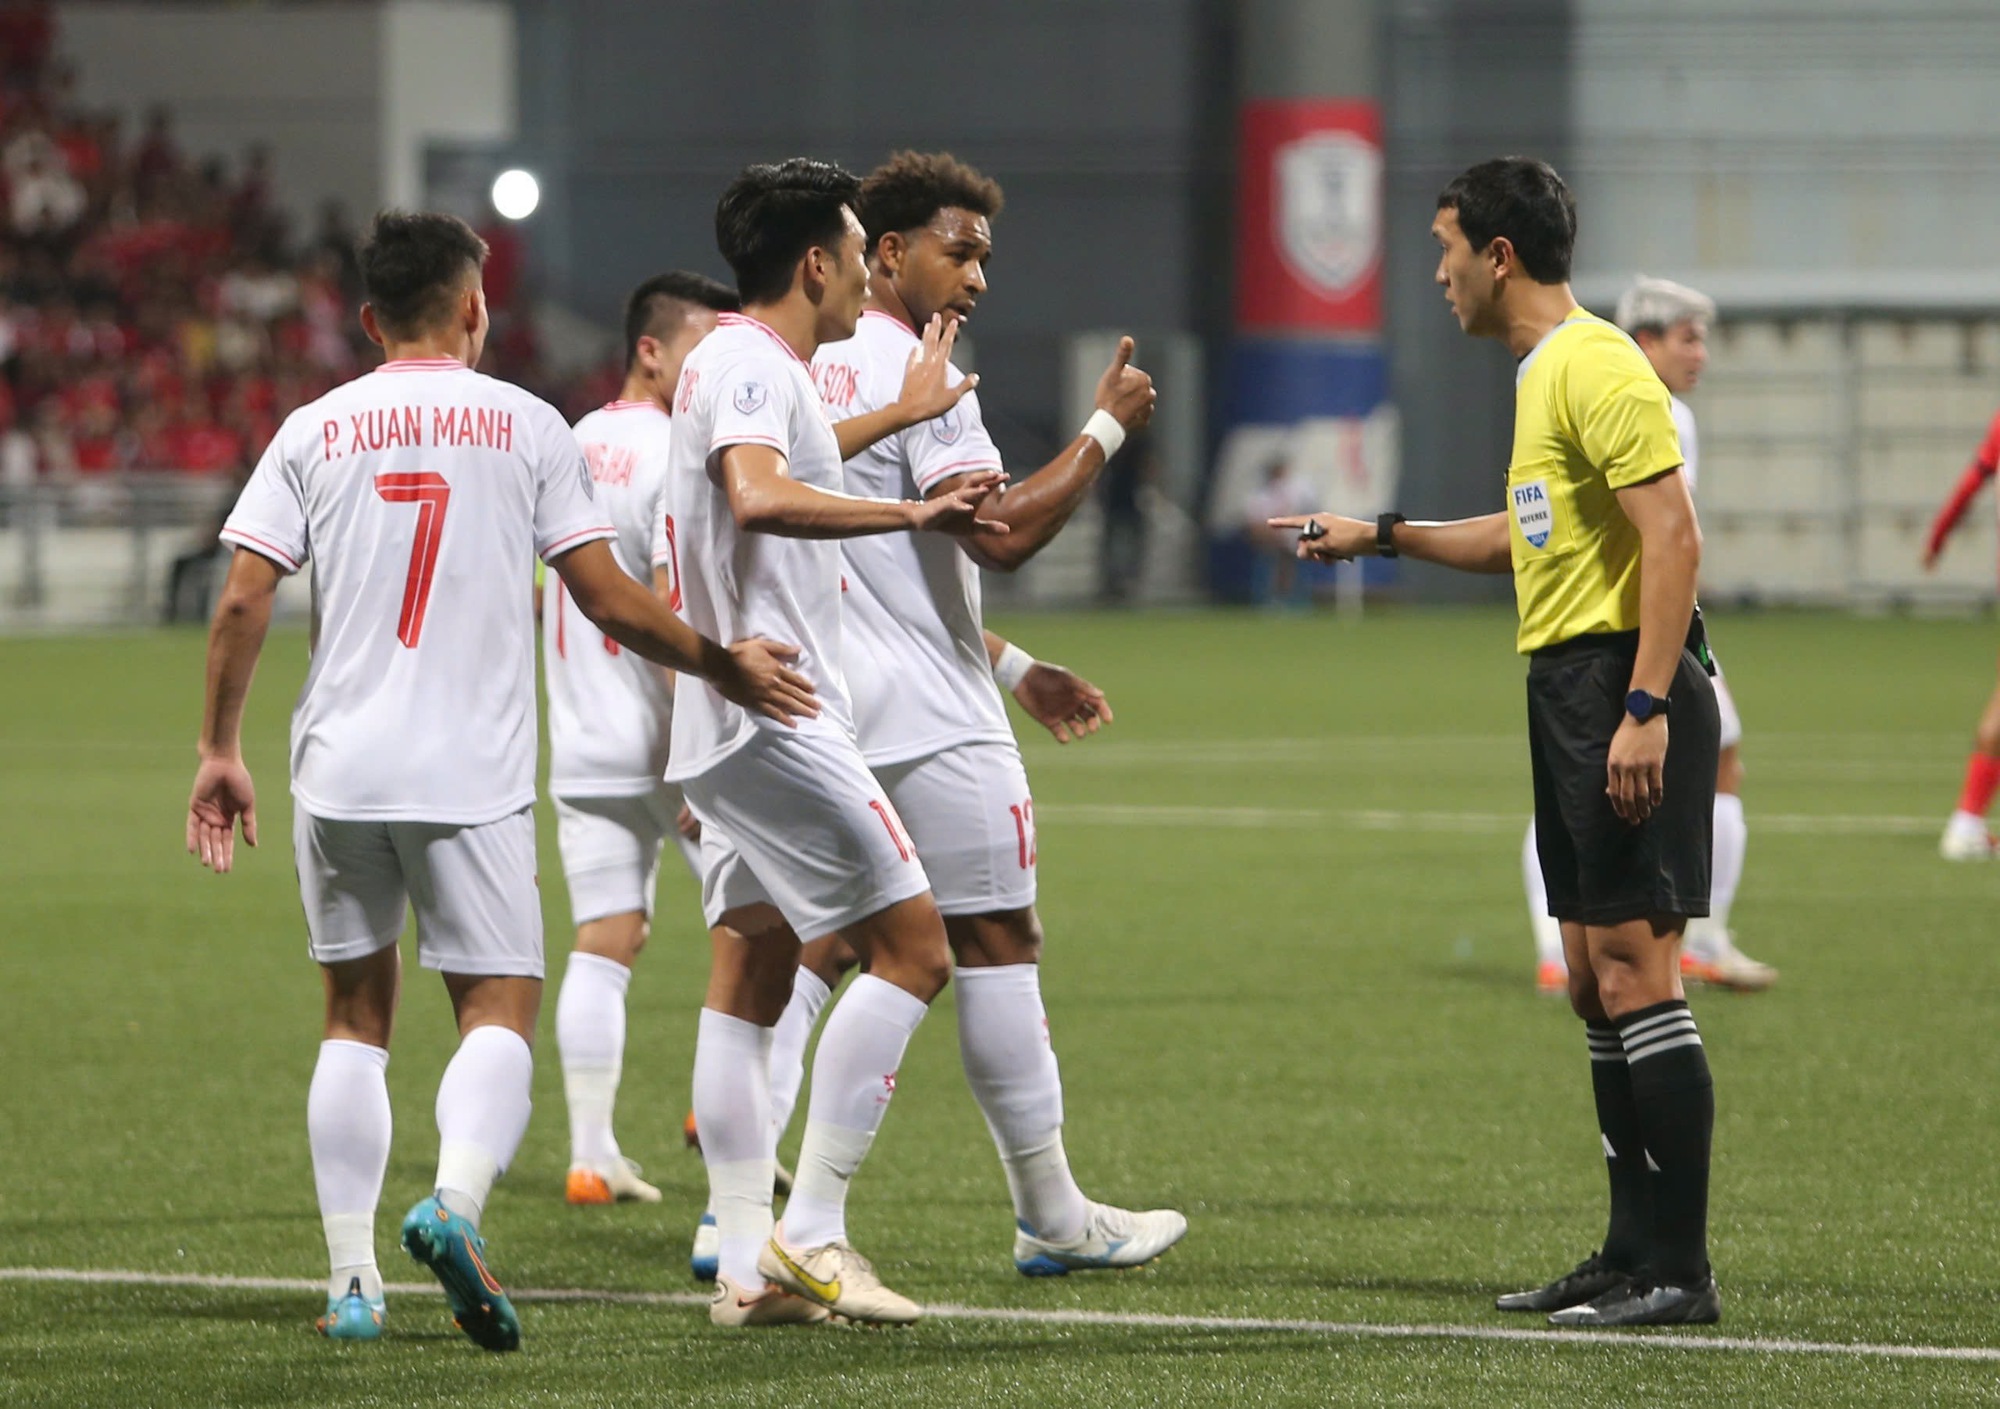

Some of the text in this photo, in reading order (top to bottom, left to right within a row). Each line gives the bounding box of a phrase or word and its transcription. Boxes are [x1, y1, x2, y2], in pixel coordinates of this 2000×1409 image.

[820, 363, 860, 407] SON
[323, 406, 513, 461] P. XUAN MANH
[1514, 485, 1544, 506] FIFA
[1520, 511, 1548, 525] REFEREE
[373, 472, 450, 649] 7
